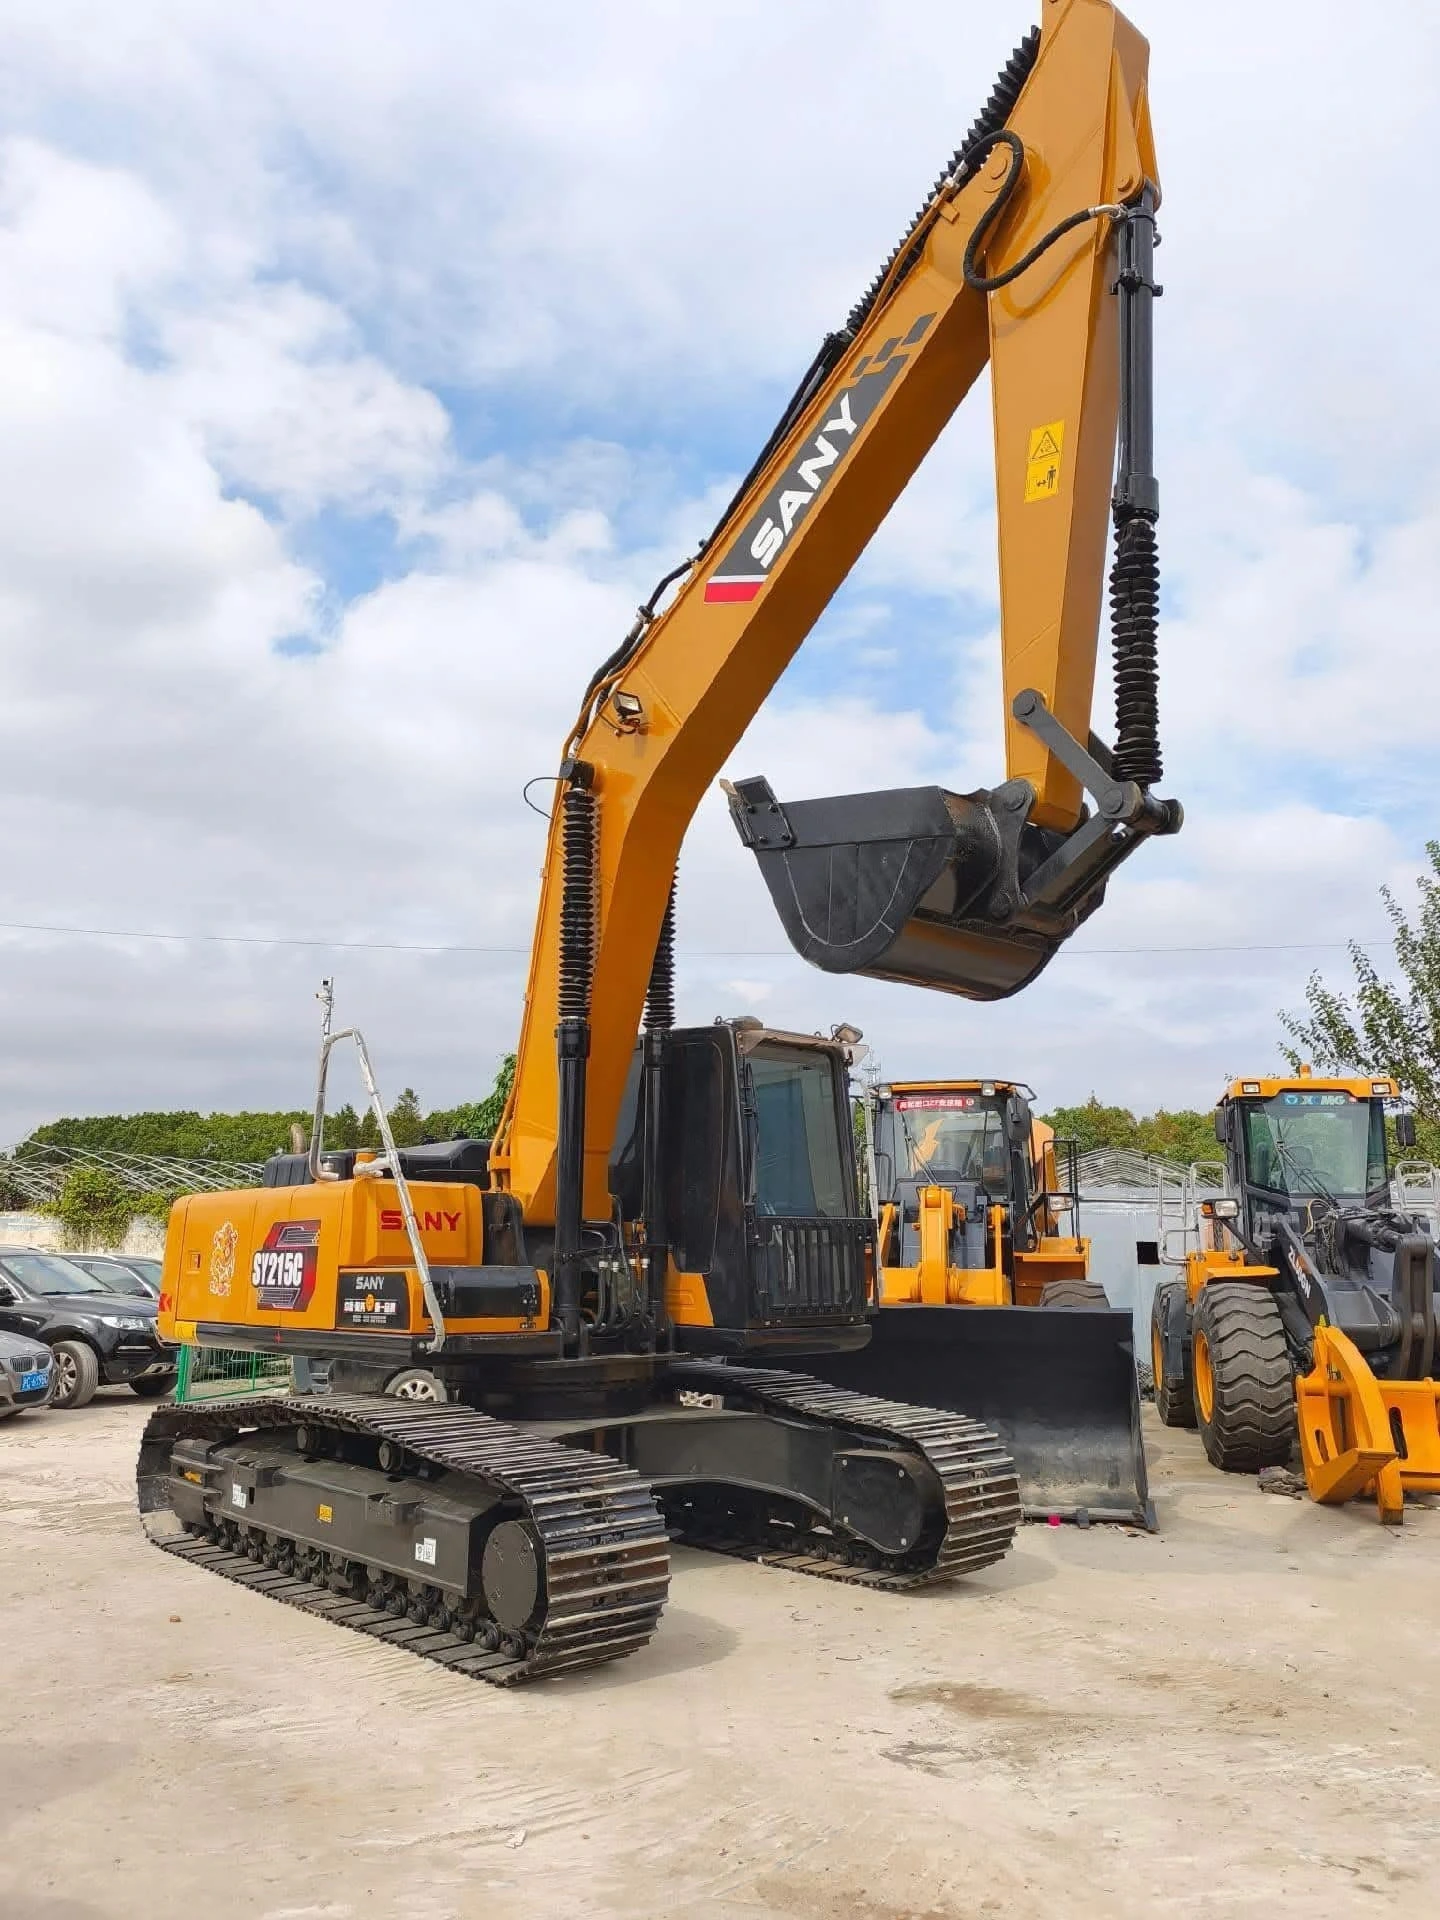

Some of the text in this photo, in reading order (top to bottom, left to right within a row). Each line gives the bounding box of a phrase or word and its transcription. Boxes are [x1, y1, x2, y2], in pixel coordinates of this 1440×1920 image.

[750, 391, 858, 569] SANY
[252, 1252, 304, 1287] SY215C
[355, 1276, 385, 1290] SANY
